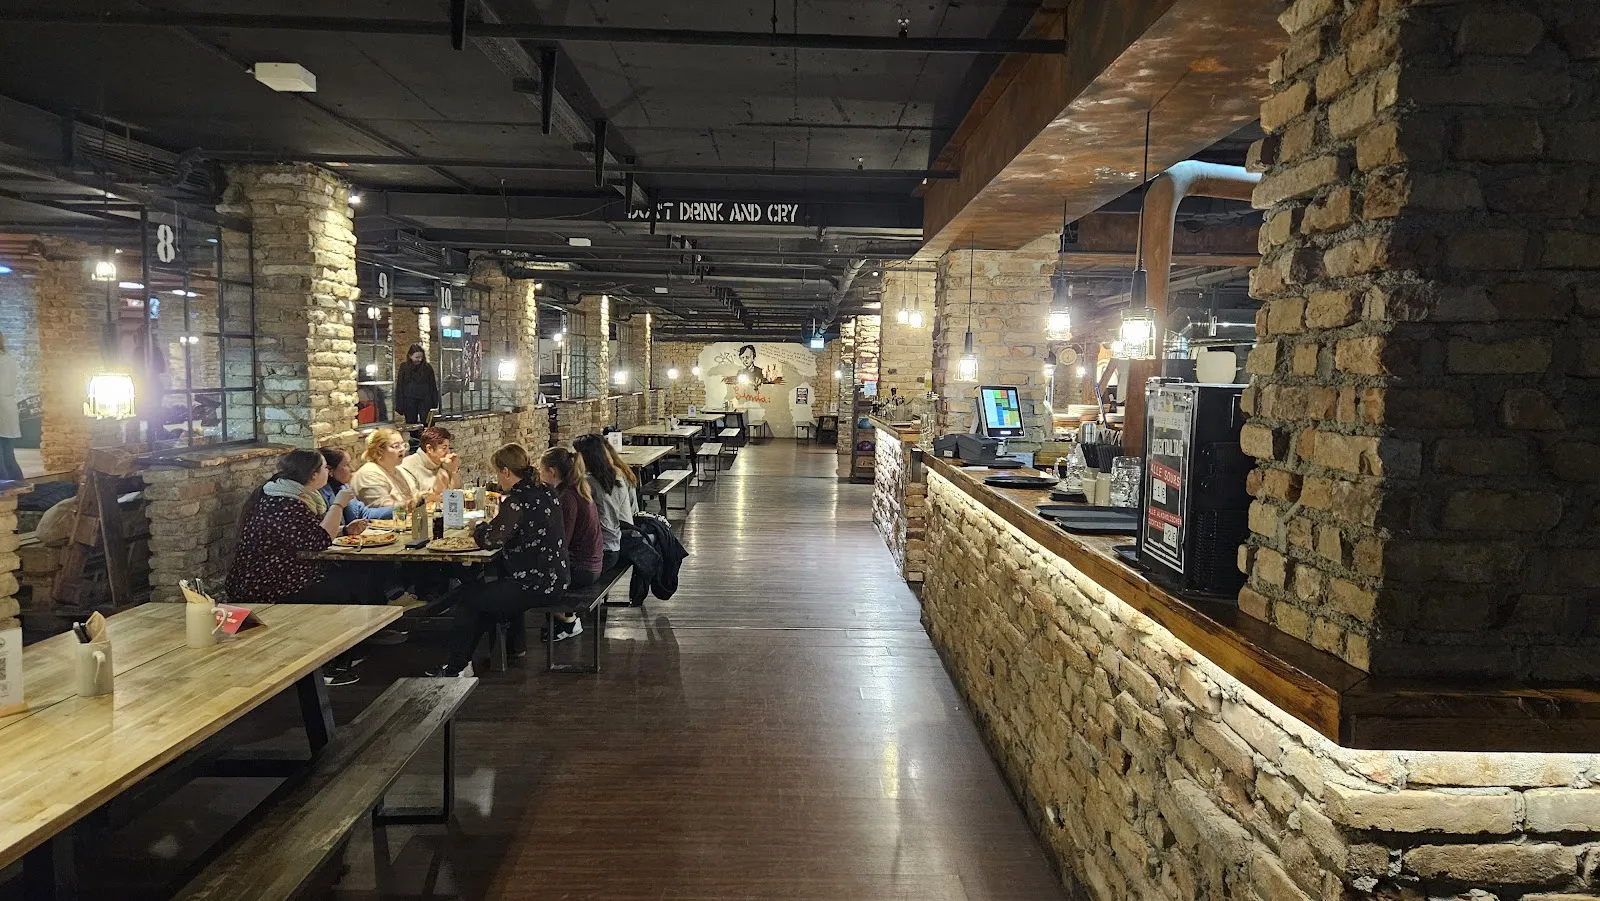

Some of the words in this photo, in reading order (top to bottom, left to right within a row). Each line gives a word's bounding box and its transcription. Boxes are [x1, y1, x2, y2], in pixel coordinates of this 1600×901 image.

[680, 202, 724, 221] DRINK
[729, 203, 762, 222] AND
[767, 204, 798, 222] CRY
[157, 224, 175, 263] 8
[379, 272, 388, 298] 9
[441, 286, 452, 309] 10
[1150, 463, 1162, 477] ALLE
[1164, 470, 1181, 487] SOURS
